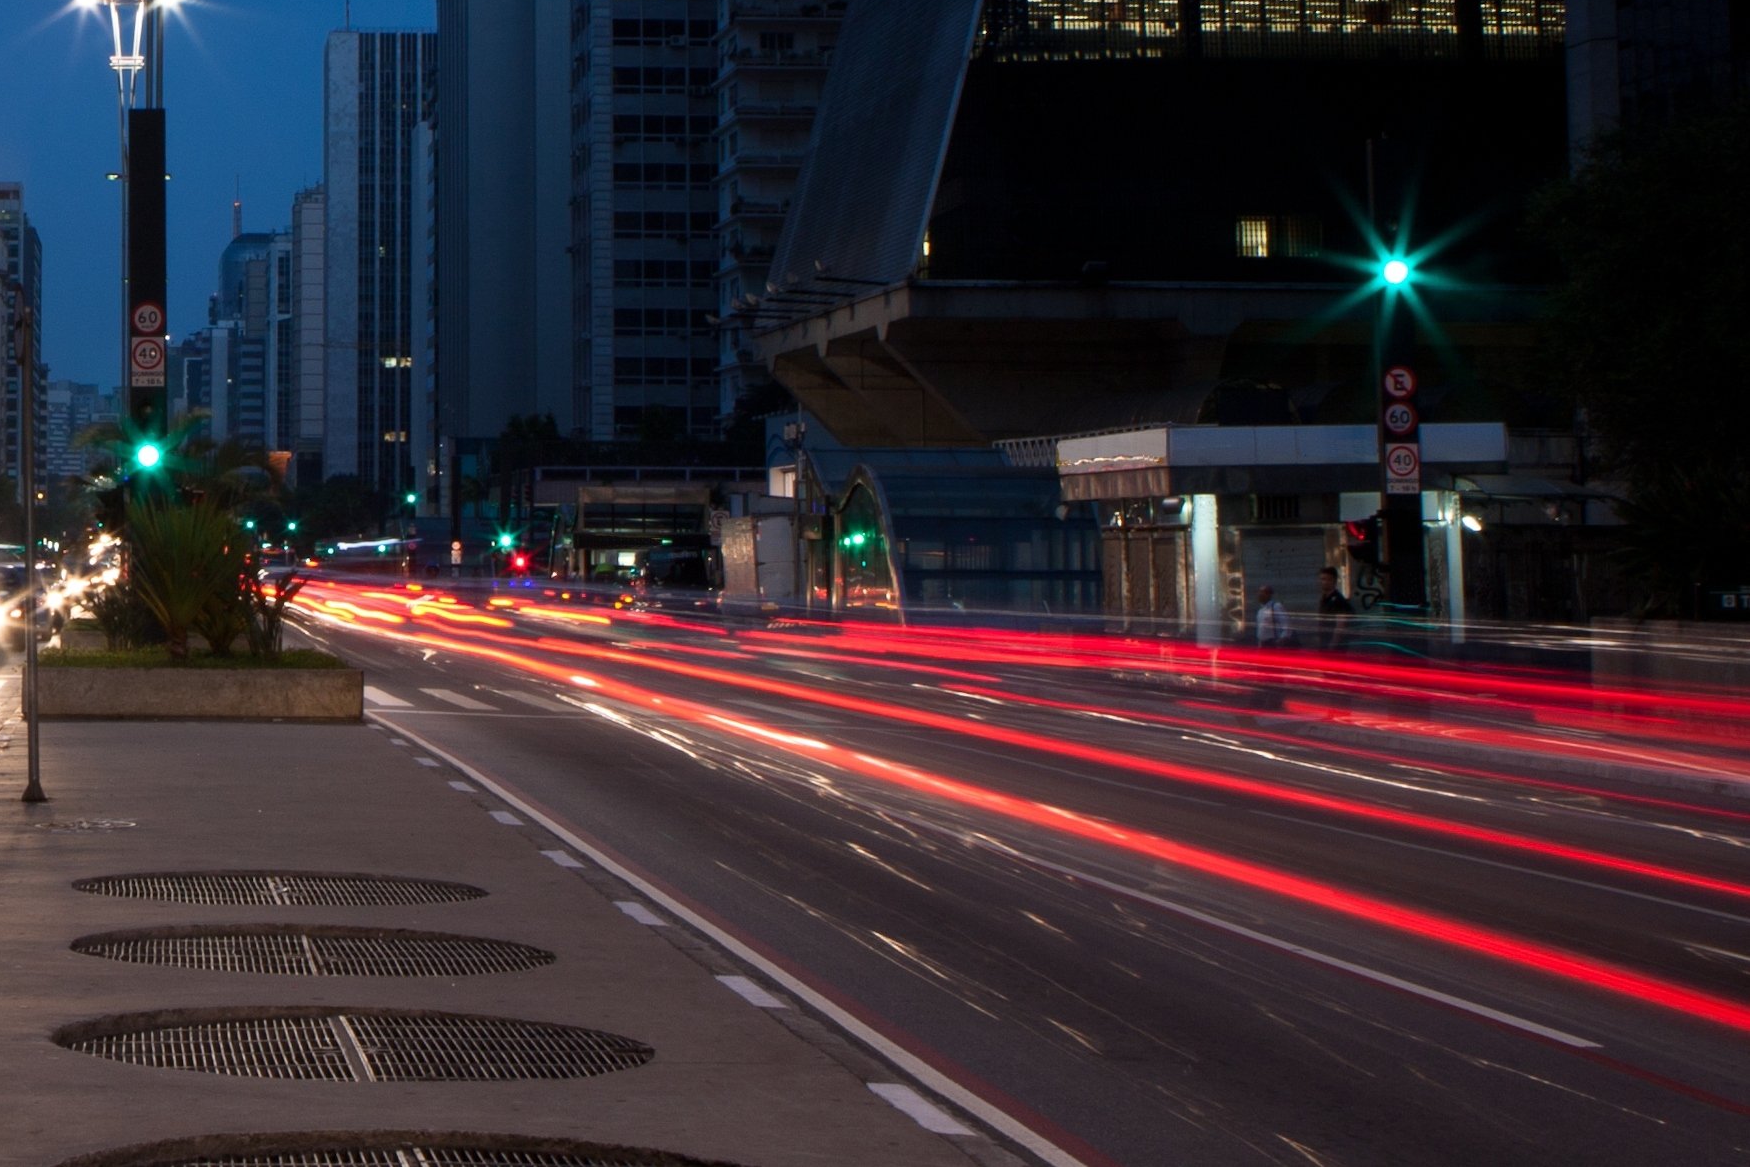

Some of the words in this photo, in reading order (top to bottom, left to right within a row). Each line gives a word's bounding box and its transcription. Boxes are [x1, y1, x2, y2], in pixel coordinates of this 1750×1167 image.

[138, 311, 157, 324] 60
[138, 347, 157, 359] 40
[1390, 410, 1410, 424] 60
[1393, 455, 1412, 466] 40
